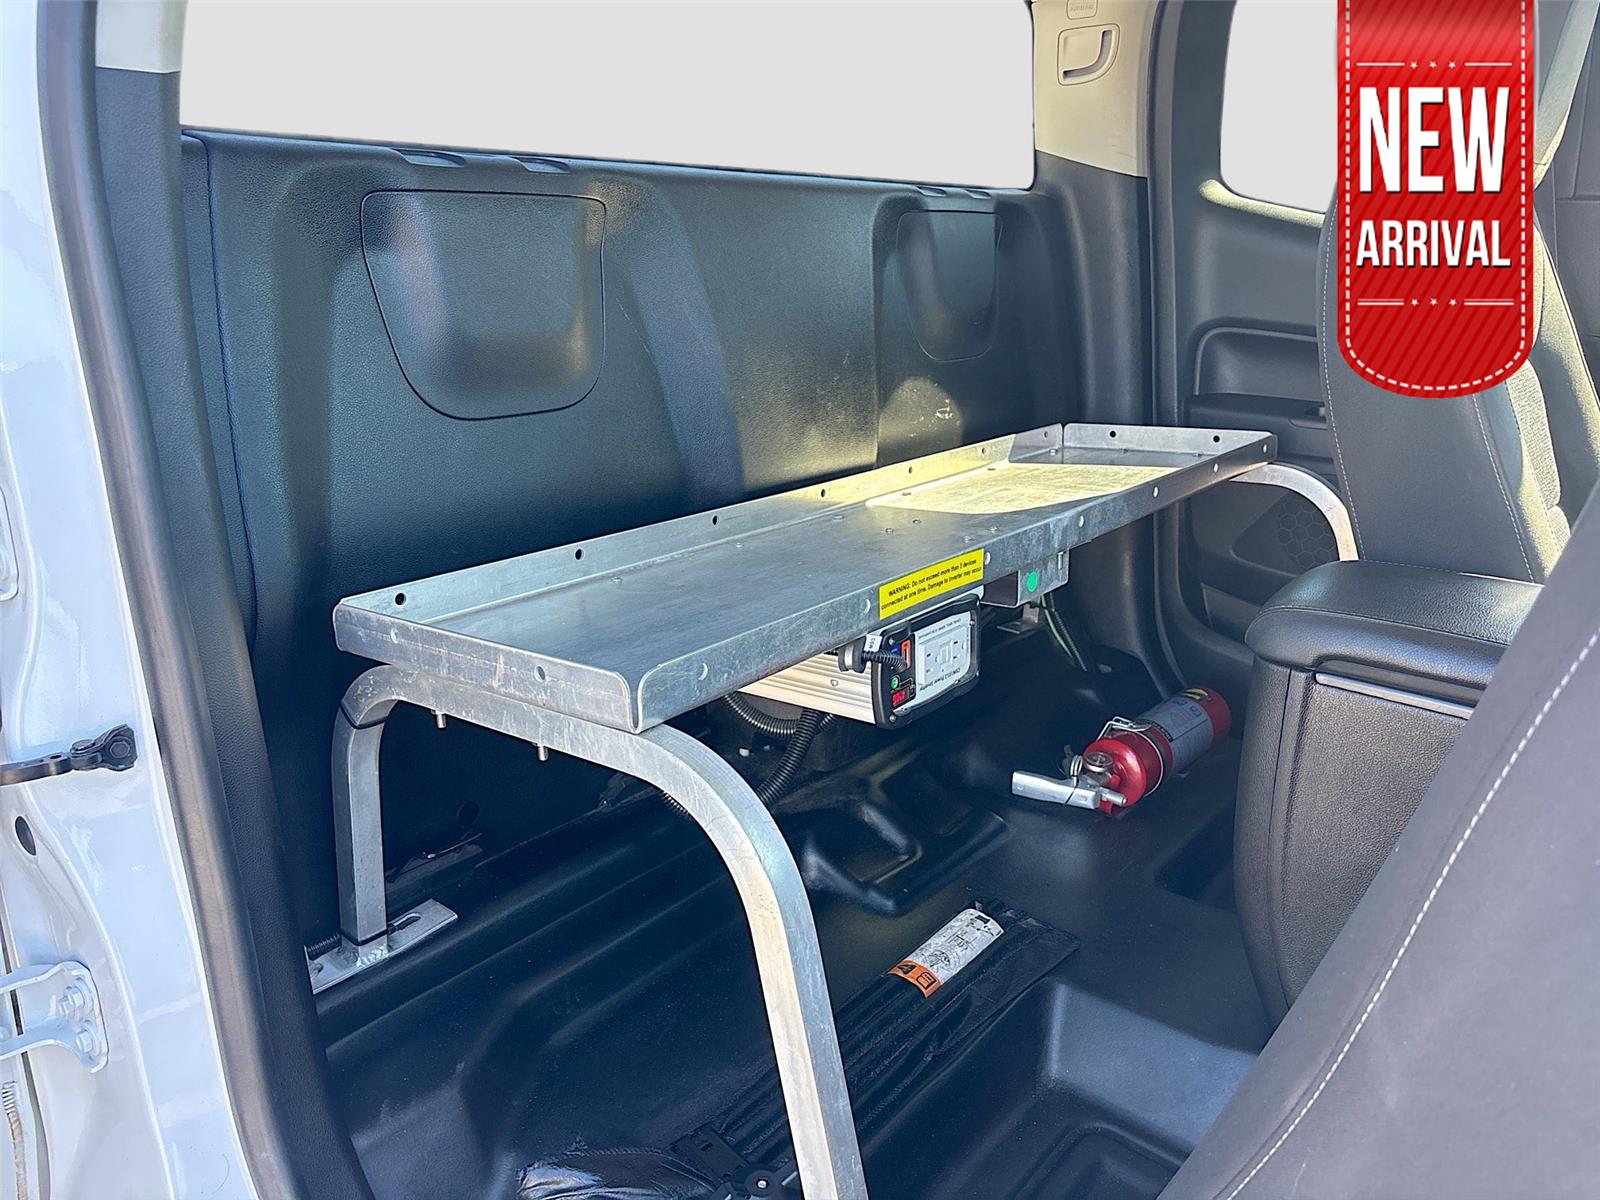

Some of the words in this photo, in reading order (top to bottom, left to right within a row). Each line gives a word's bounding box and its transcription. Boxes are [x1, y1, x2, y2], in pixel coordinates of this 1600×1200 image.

[880, 596, 904, 610] connected
[928, 580, 944, 590] Damage
[888, 582, 911, 597] WARNING:
[926, 572, 940, 581] exceed
[962, 560, 976, 568] devices
